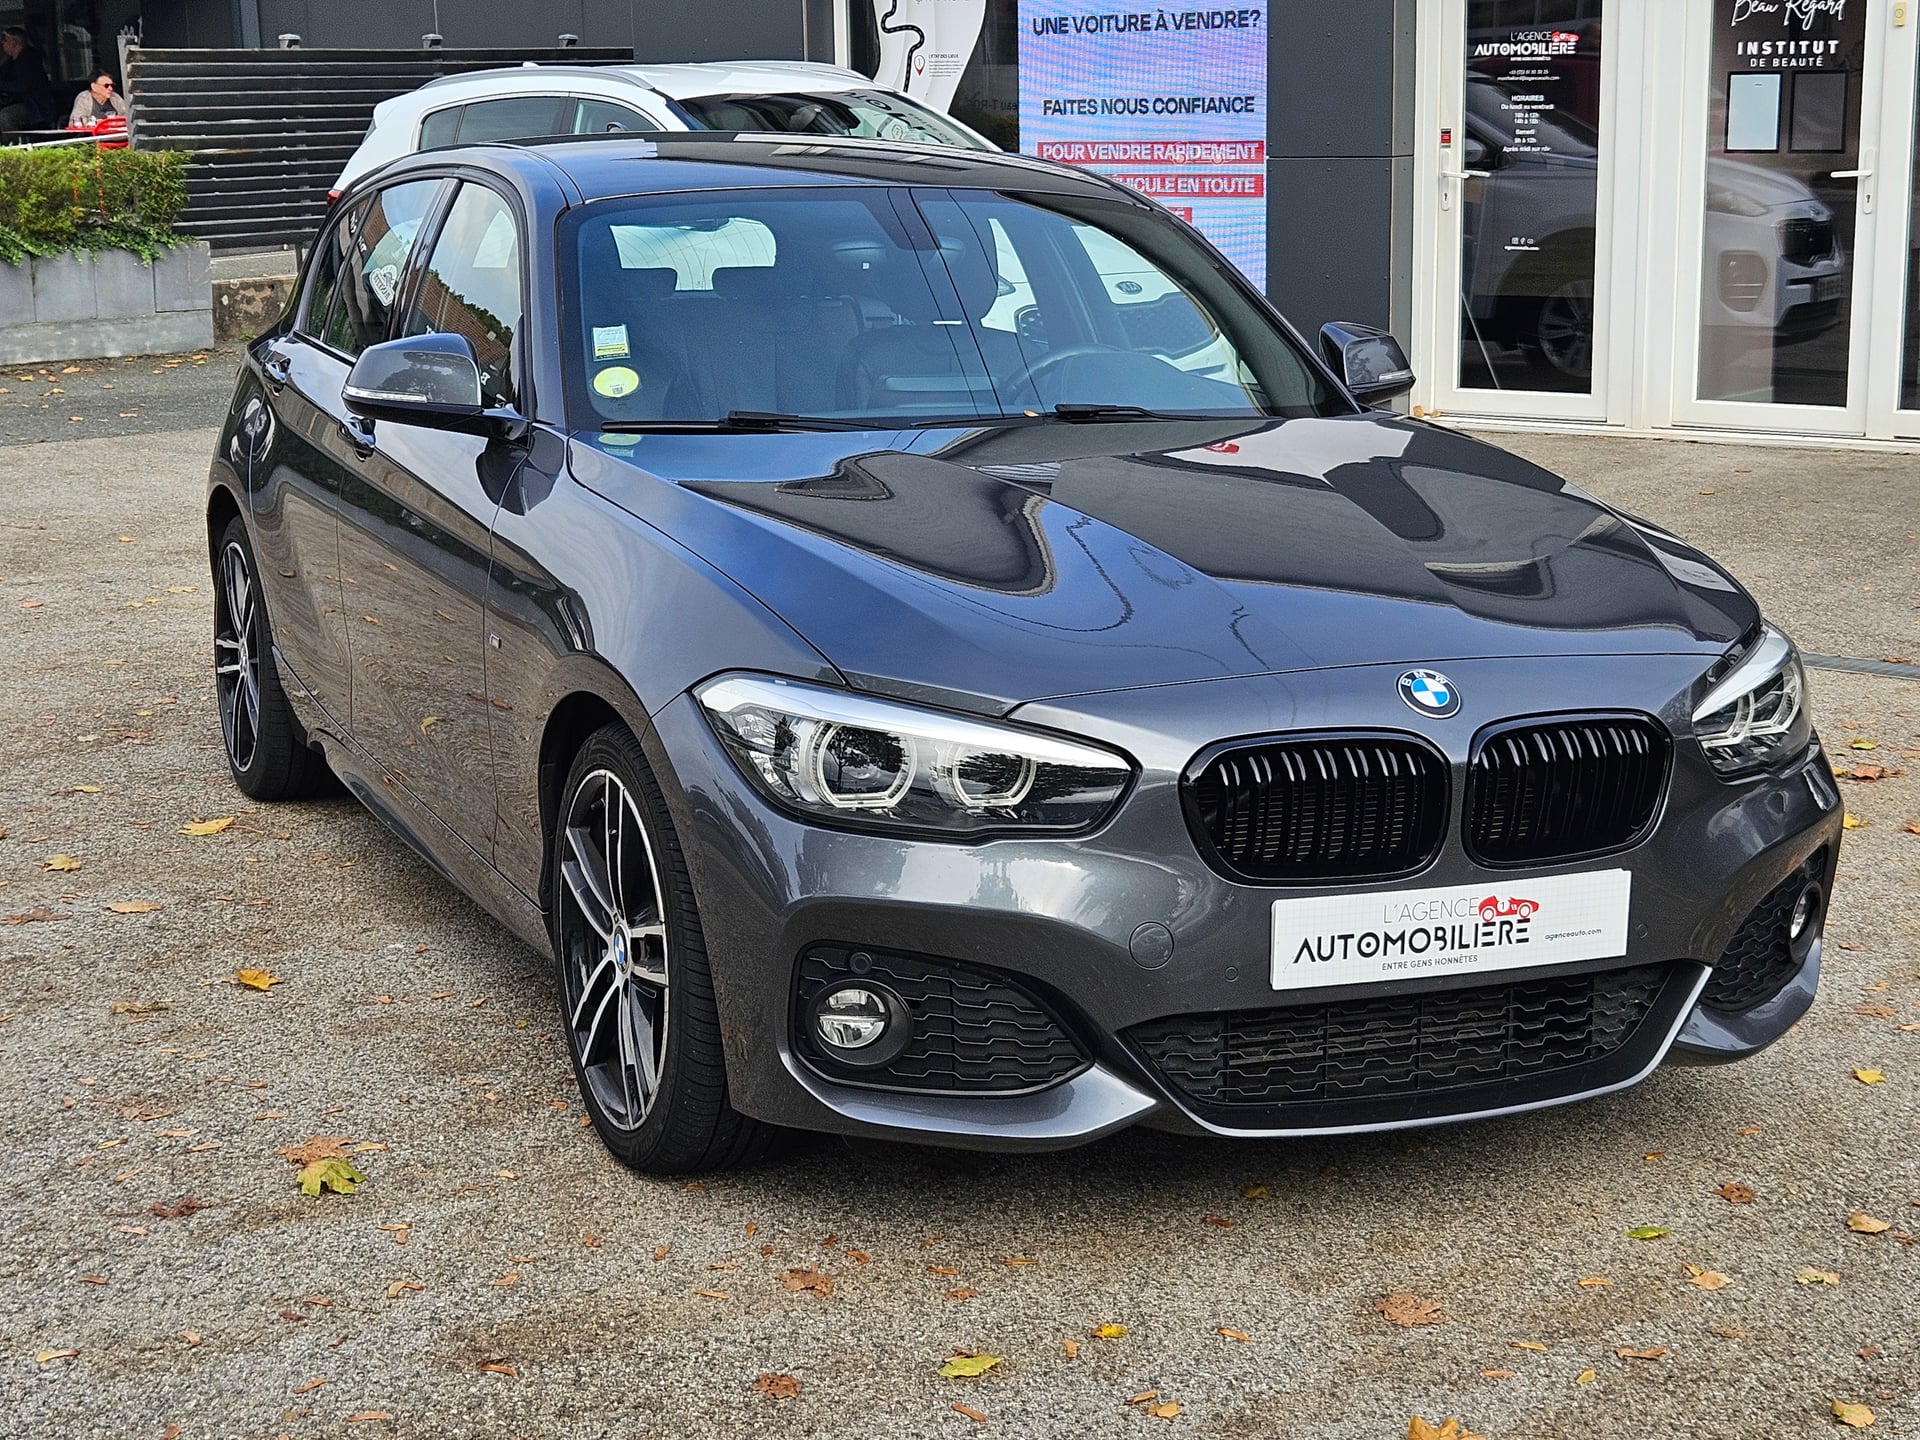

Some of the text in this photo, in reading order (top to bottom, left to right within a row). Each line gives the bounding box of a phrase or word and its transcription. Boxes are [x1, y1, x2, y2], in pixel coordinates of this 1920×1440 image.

[1033, 8, 1261, 36] UNE VOITURE À VENDRE?
[1510, 31, 1552, 41] L'AGENCE
[1737, 40, 1840, 56] INSTITUT
[1750, 55, 1824, 67] DE BEAUTÉ
[1043, 96, 1255, 115] FAITES NOUS CONFIANCE
[1043, 143, 1258, 160] POUR VENDRE RAPIDEMENT
[1112, 175, 1255, 193] HICULE EN TOUTE
[1401, 671, 1447, 687] BMW
[1383, 897, 1479, 923] L'AGENCE
[1544, 928, 1602, 941] agenceauto.com
[1382, 954, 1478, 970] ENTRE GENS HONNÊTES
